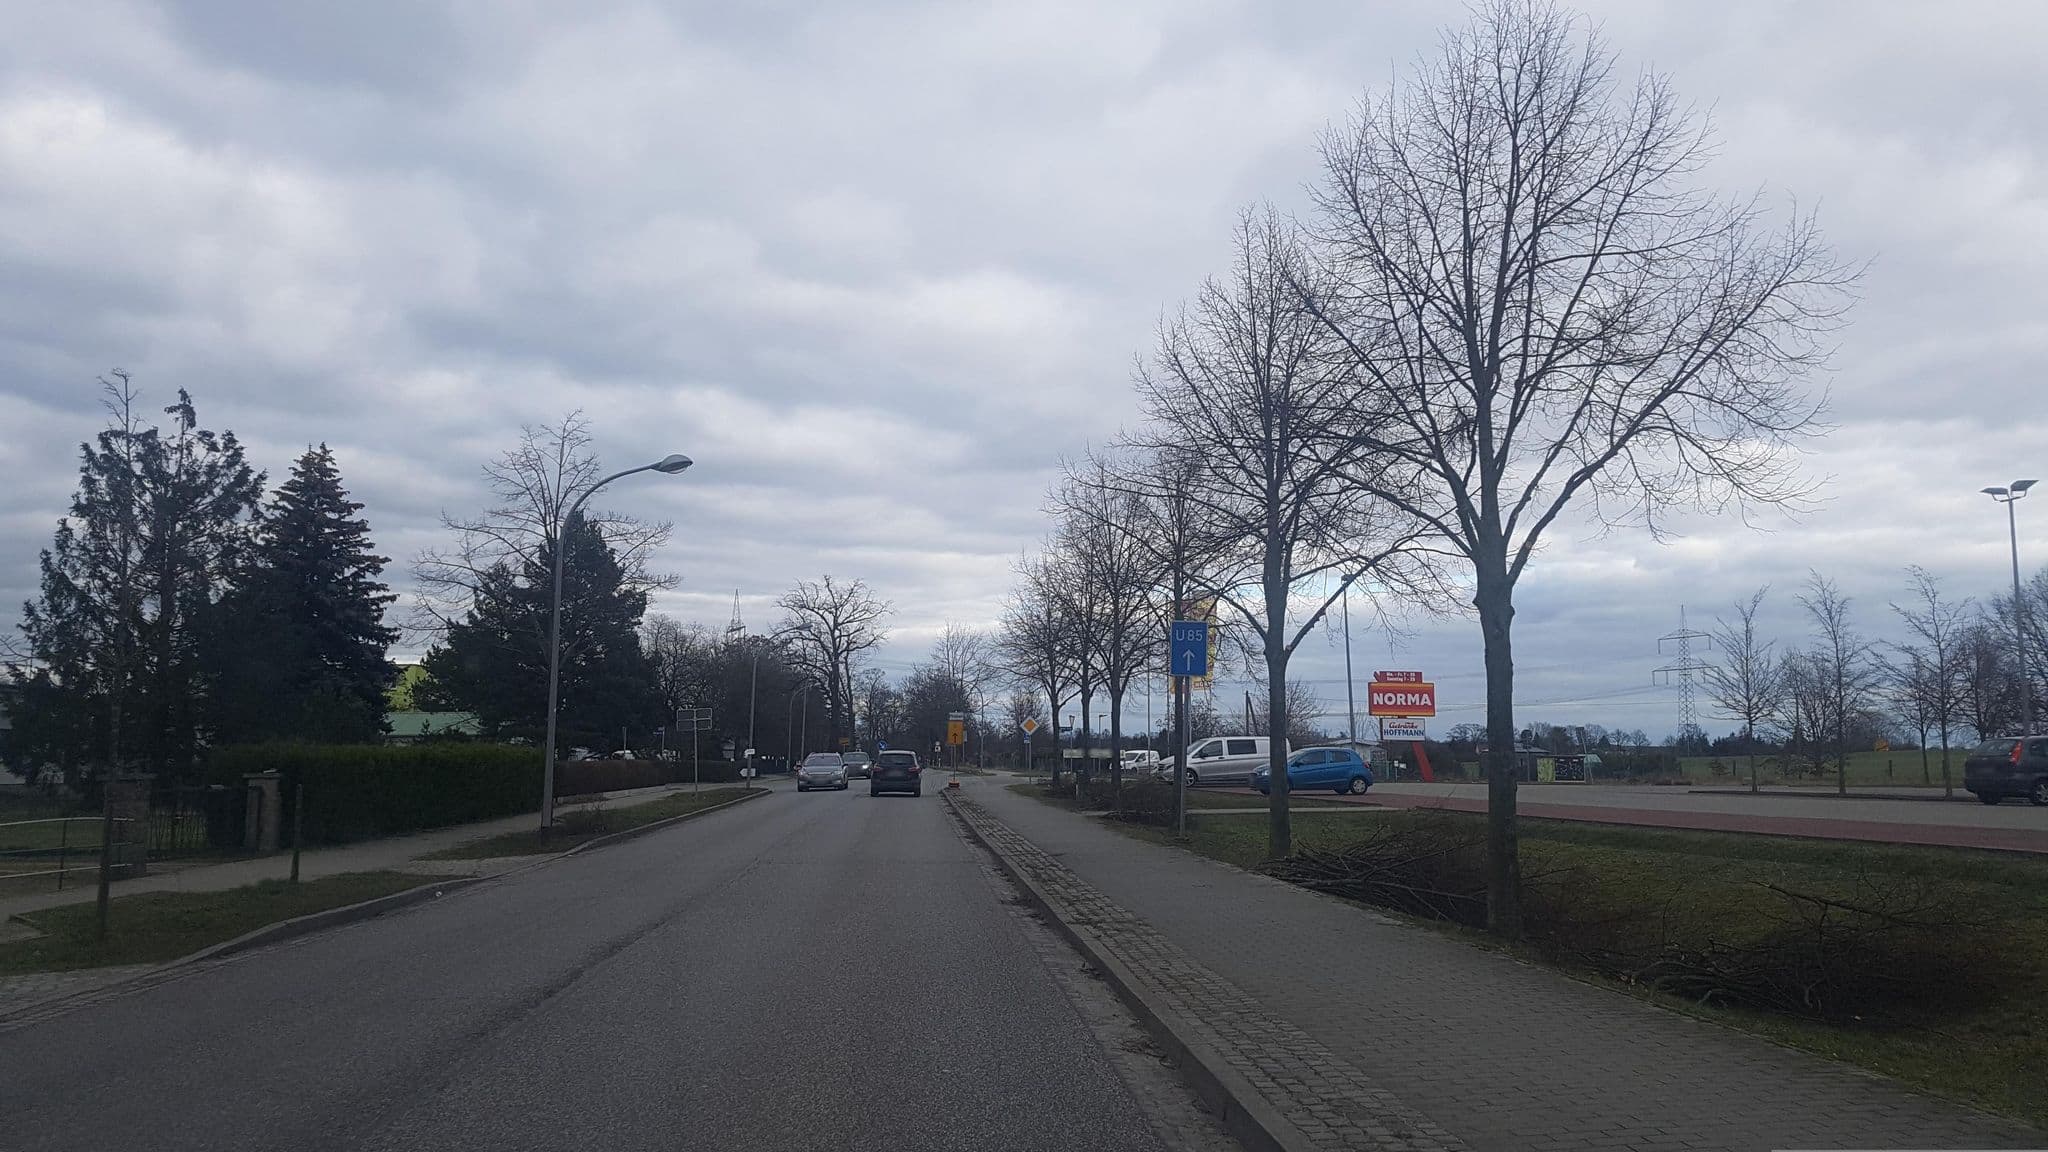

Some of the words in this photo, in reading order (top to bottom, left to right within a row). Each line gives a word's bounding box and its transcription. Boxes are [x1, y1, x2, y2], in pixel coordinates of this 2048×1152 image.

[1175, 629, 1185, 641] U
[1187, 629, 1203, 641] 85
[1373, 692, 1432, 706] NORMA
[1383, 728, 1424, 736] HOFFMANN
